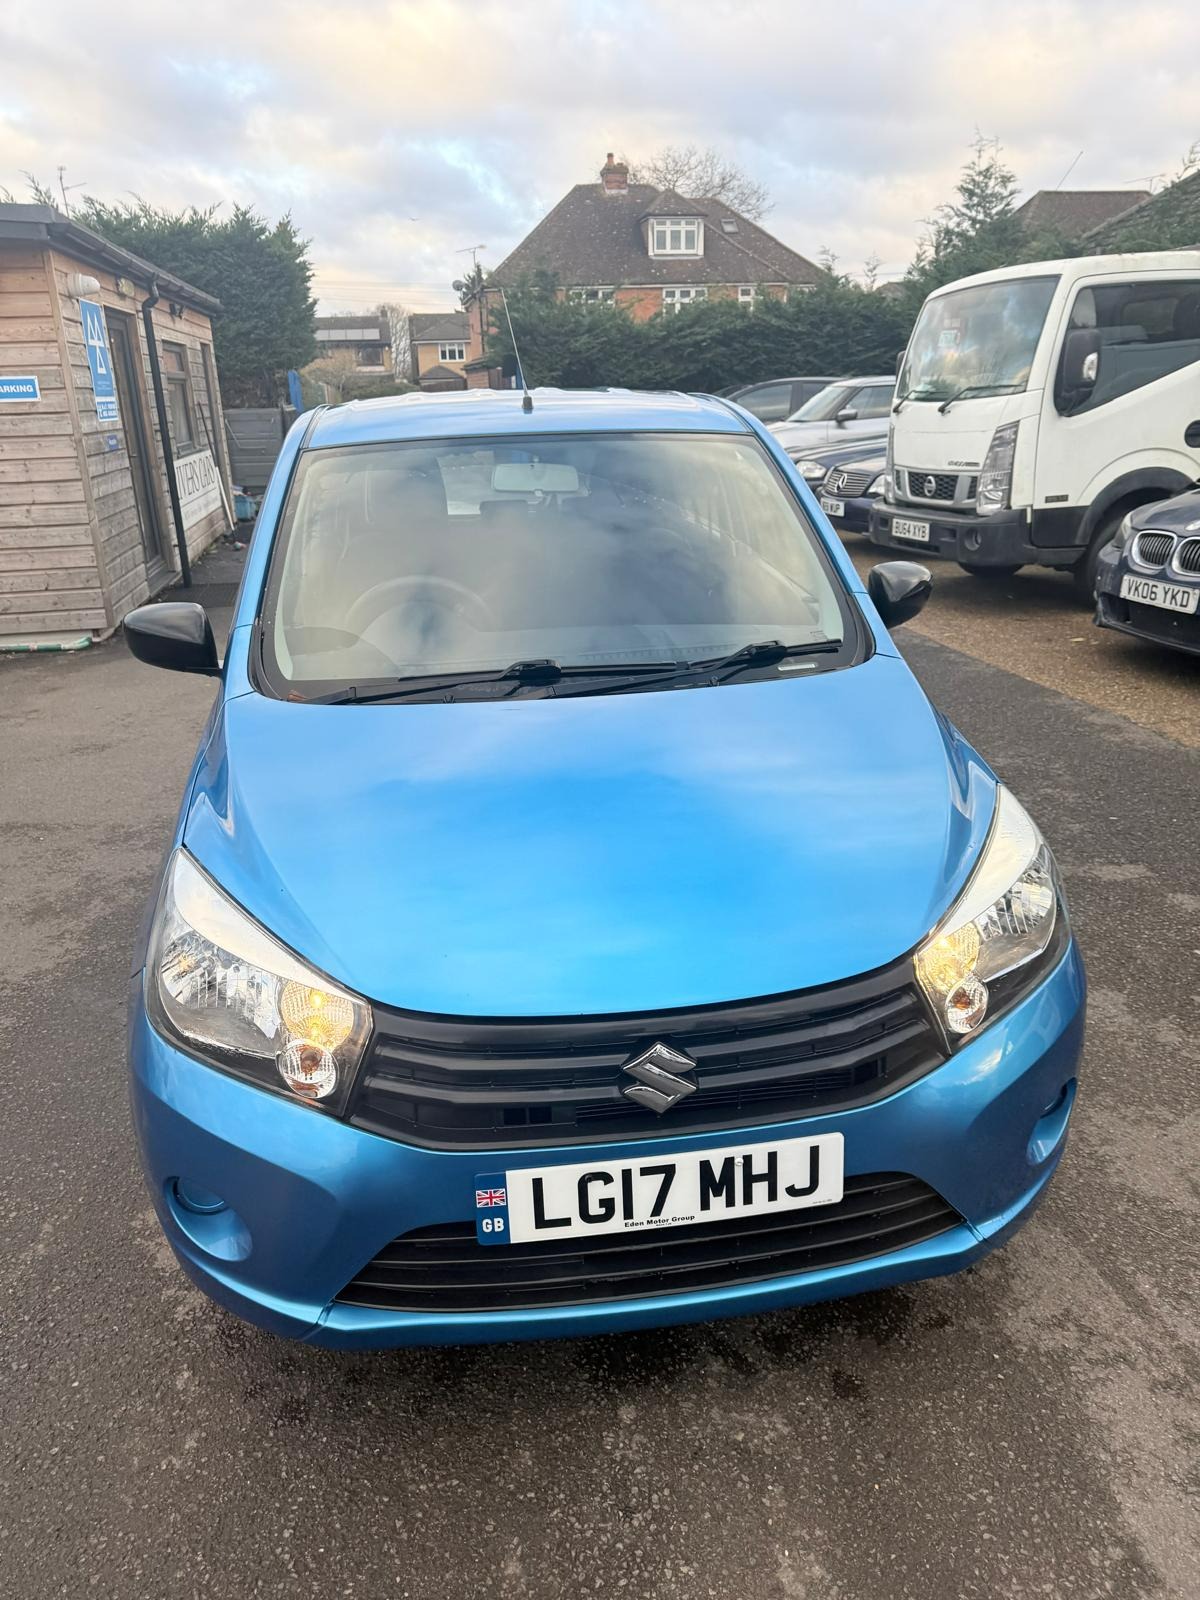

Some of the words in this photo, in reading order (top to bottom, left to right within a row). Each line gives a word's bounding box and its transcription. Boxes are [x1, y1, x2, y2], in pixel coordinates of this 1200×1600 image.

[1128, 579, 1158, 601] VK06
[1163, 586, 1190, 608] YKD
[532, 1164, 677, 1230] LG17
[699, 1145, 820, 1212] MHJ
[482, 1218, 504, 1232] GB
